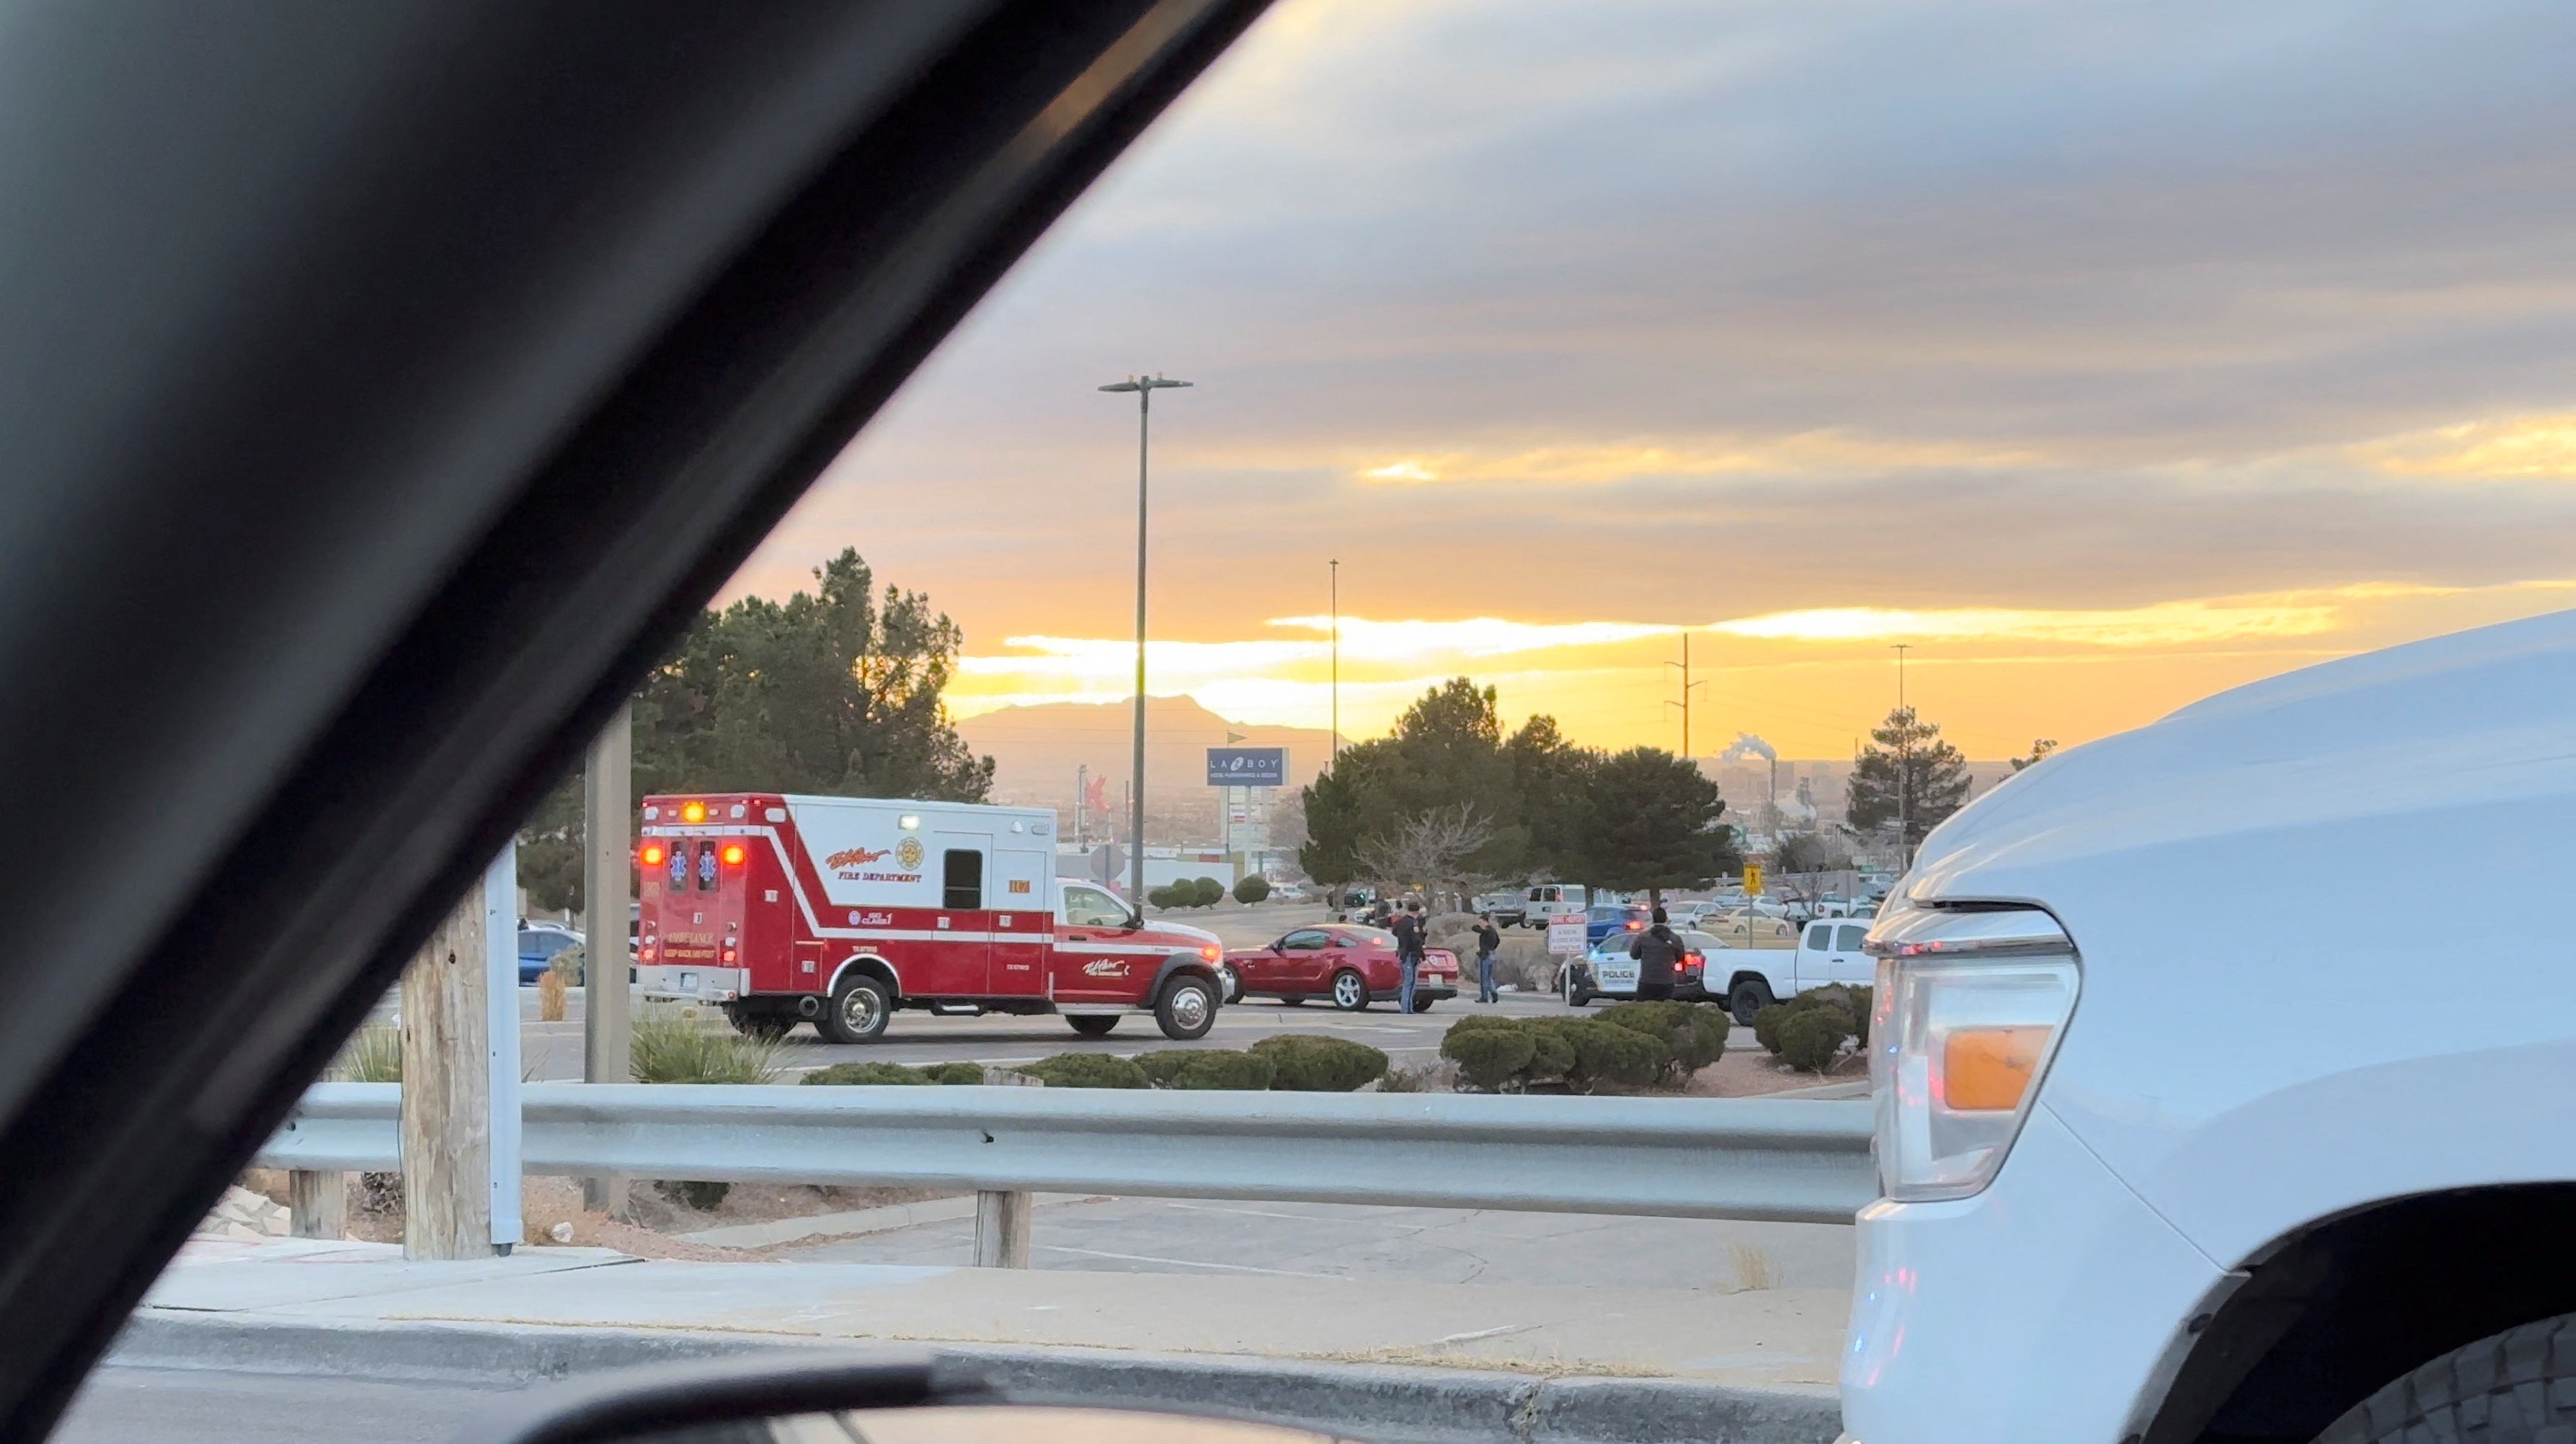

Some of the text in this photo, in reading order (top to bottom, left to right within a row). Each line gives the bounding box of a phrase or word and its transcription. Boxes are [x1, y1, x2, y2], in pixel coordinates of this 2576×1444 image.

[838, 870, 922, 883] FIRE DEPARTMENT
[666, 932, 715, 945] AMBULANCE
[1602, 970, 1635, 979] POLICE
